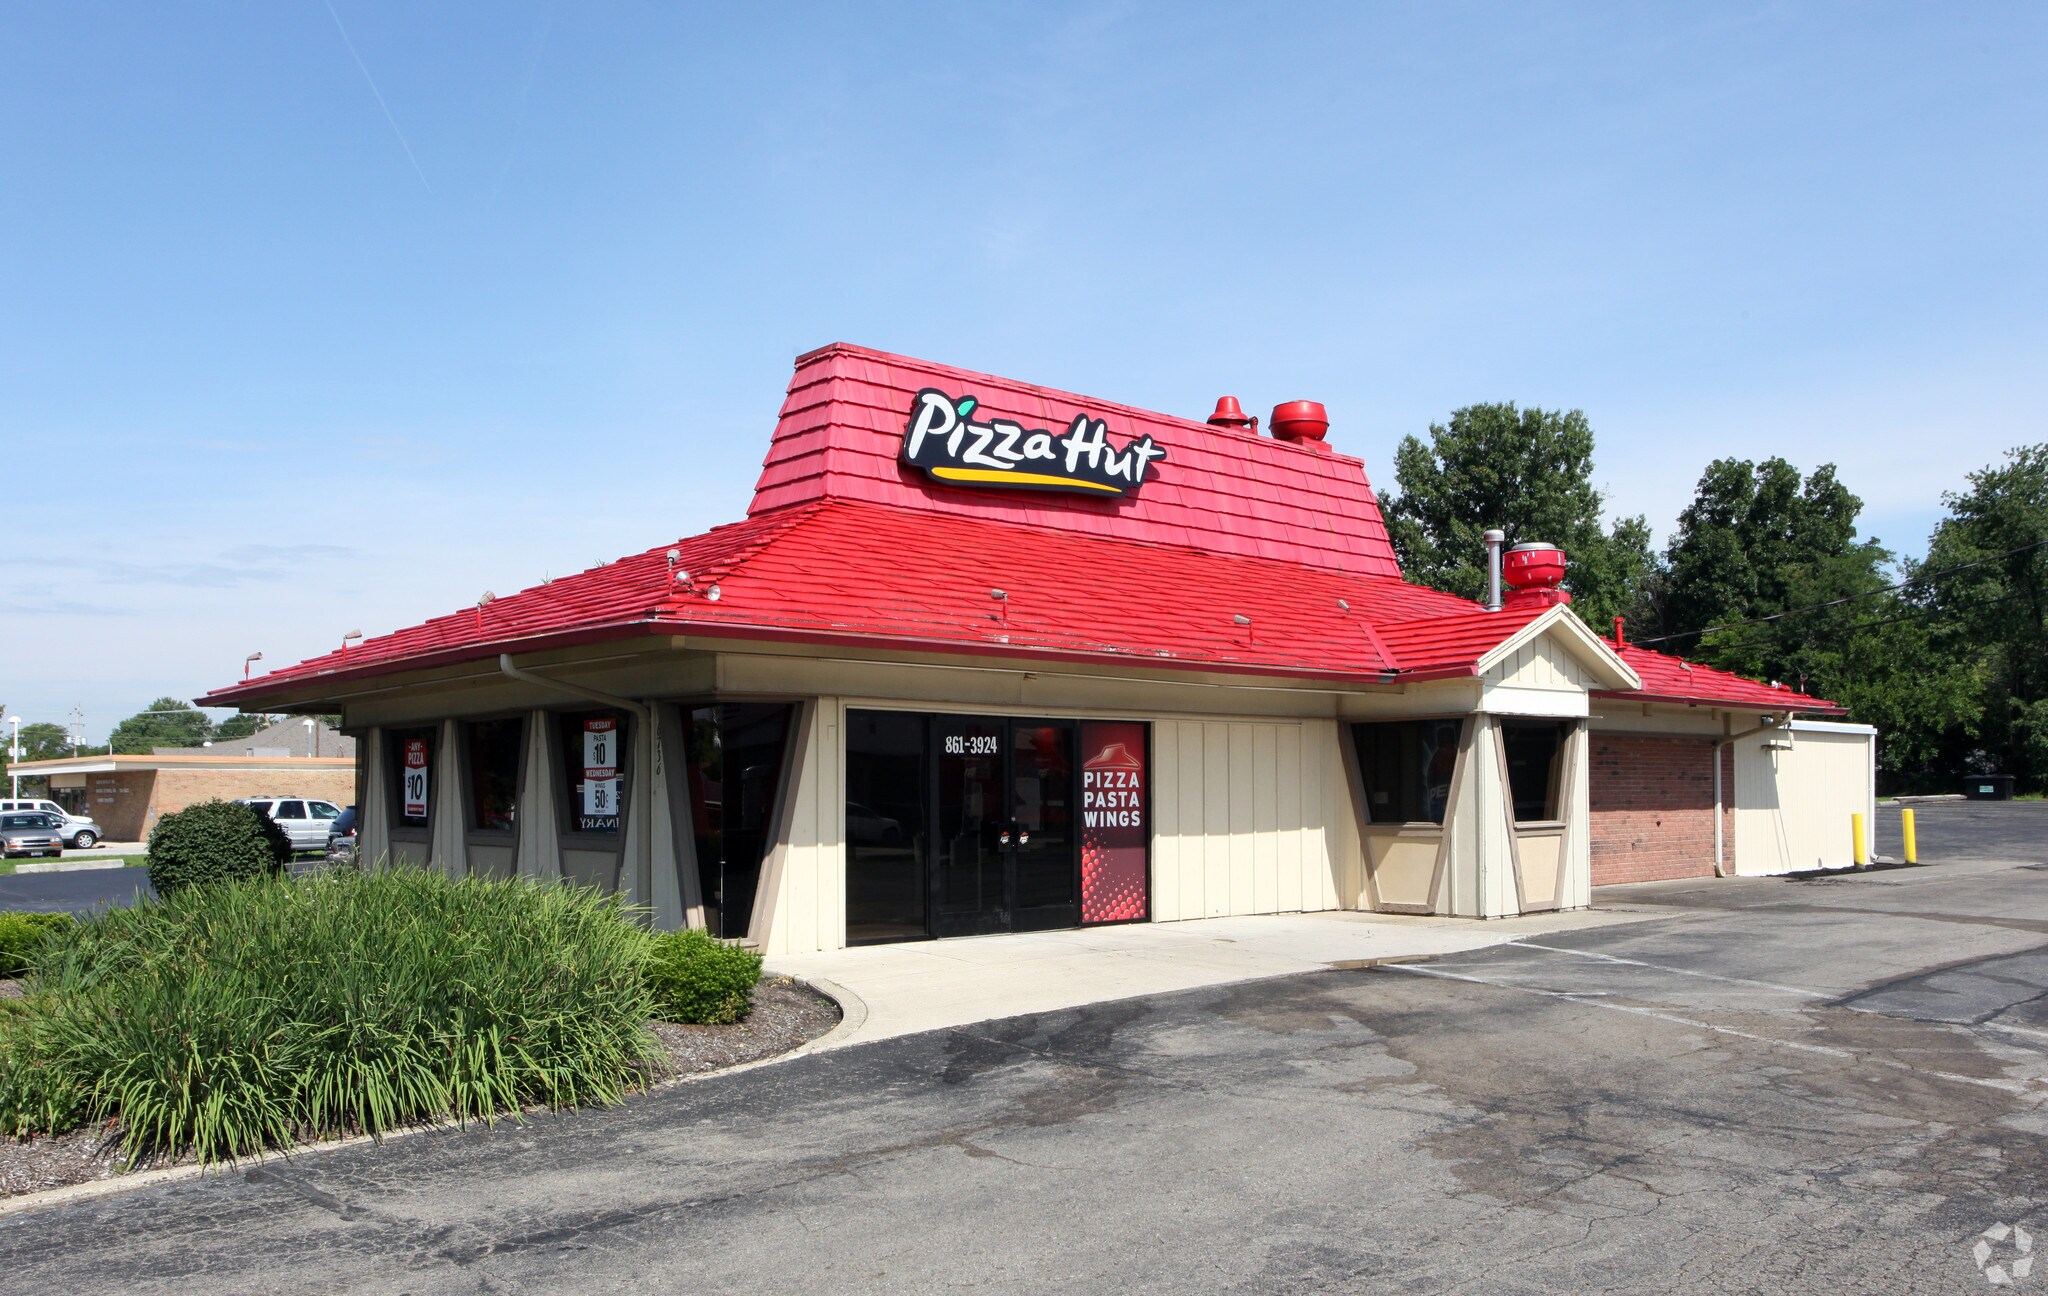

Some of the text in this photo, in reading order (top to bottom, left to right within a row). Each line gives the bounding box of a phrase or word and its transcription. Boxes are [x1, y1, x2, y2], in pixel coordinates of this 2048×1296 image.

[909, 393, 1165, 483] Pizza Hut
[589, 721, 611, 729] TUESDAY
[593, 734, 607, 742] PASTA
[945, 736, 998, 754] 861-3924
[408, 752, 424, 765] PIZZA
[593, 743, 606, 765] $10
[586, 768, 615, 777] WEDNESDAY
[1083, 771, 1140, 788] PIZZA
[408, 774, 423, 800] $10
[1430, 784, 1450, 800] PE
[1083, 790, 1141, 808] PASTA
[1083, 809, 1142, 828] WINGS
